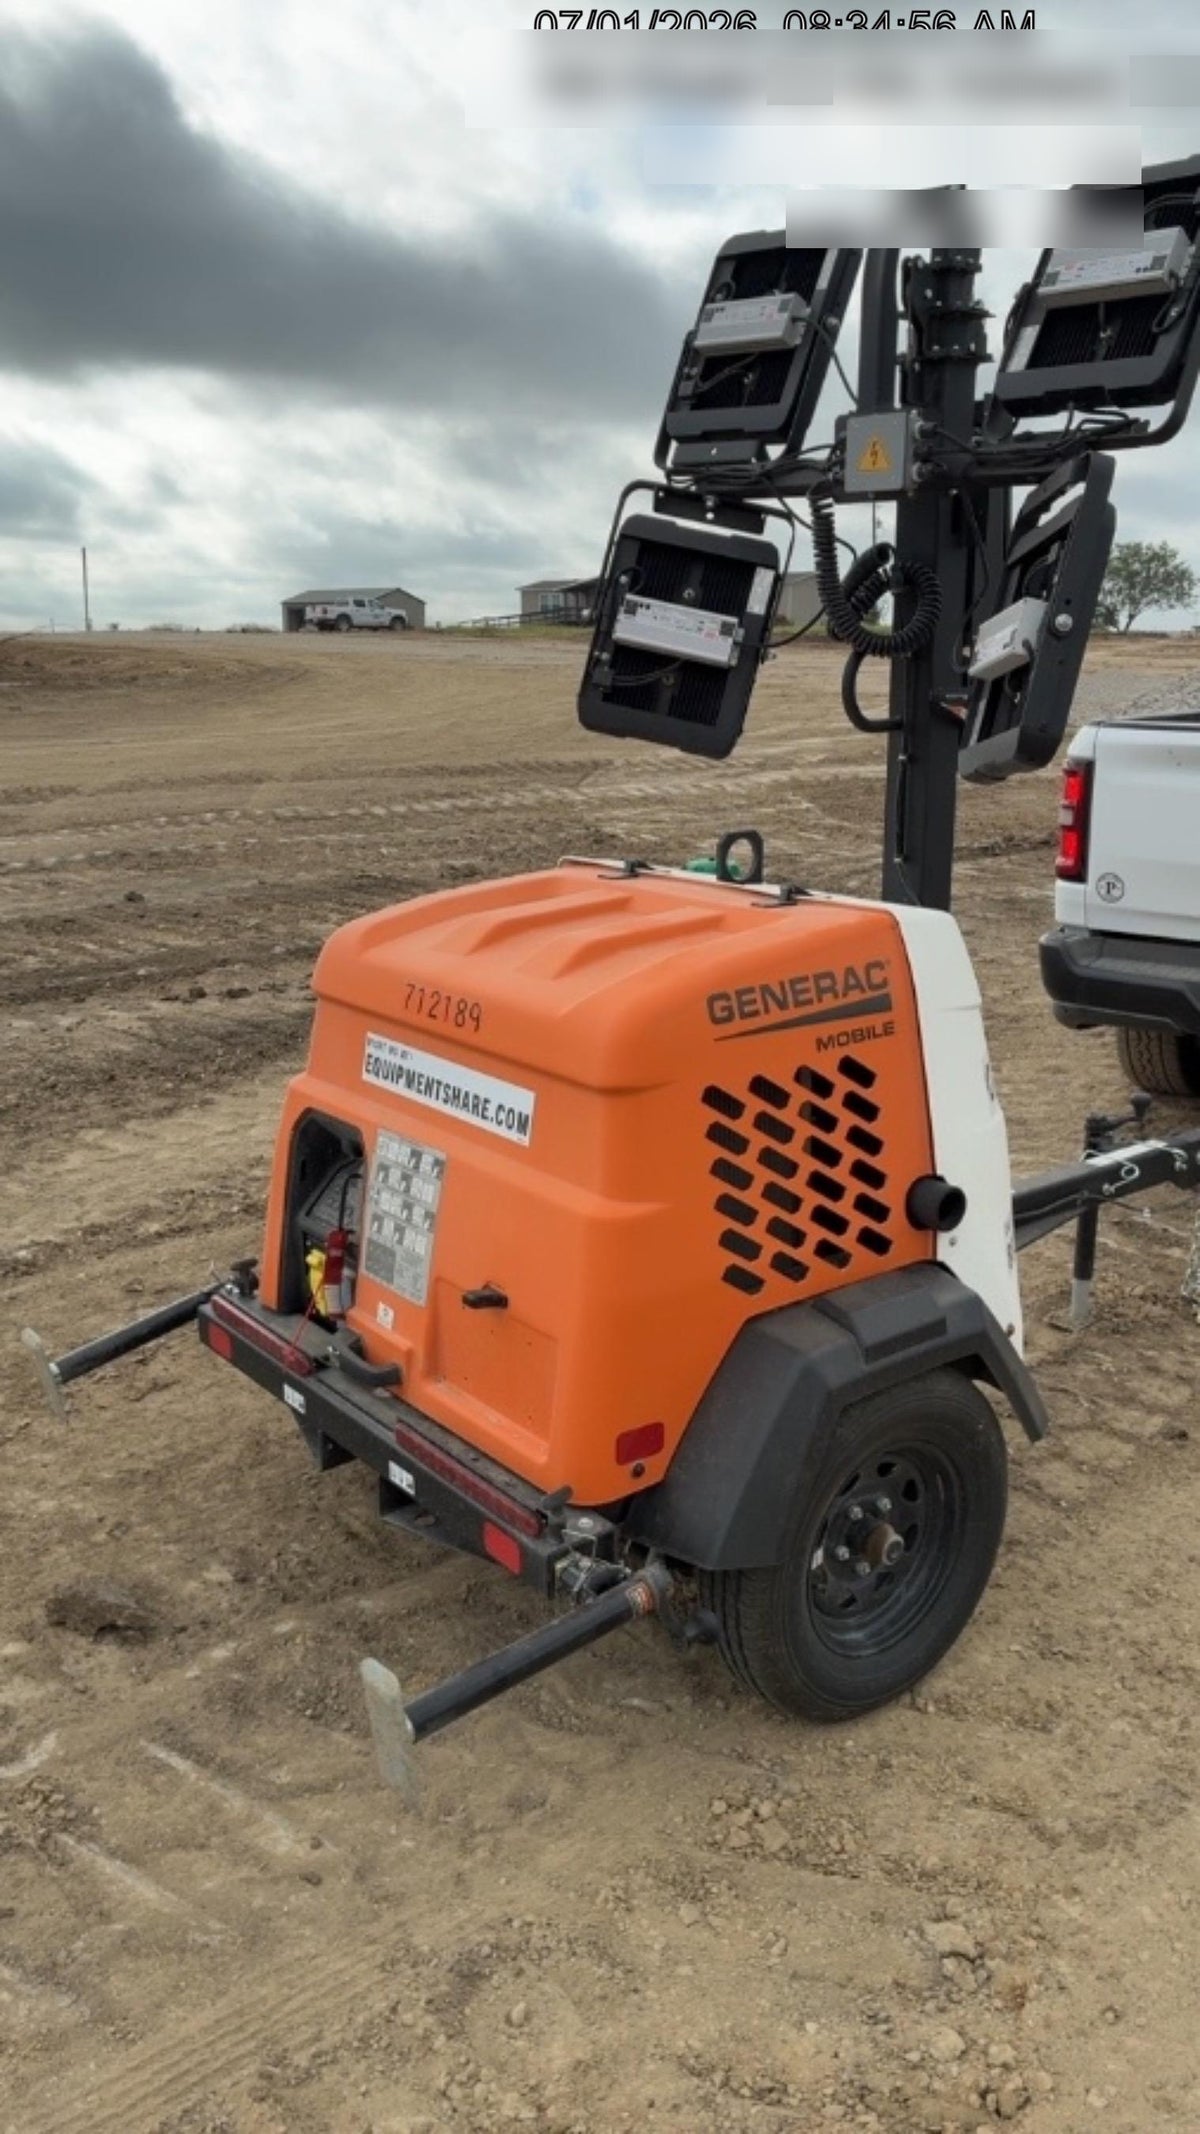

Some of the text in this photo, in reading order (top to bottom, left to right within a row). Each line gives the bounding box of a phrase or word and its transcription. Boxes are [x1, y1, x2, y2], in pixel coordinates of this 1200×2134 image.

[403, 983, 482, 1033] 712189
[706, 960, 889, 1025] GENERAC
[815, 1021, 896, 1053] MOBILE
[365, 1053, 530, 1137] EQUIPMENTSHARE.COM
